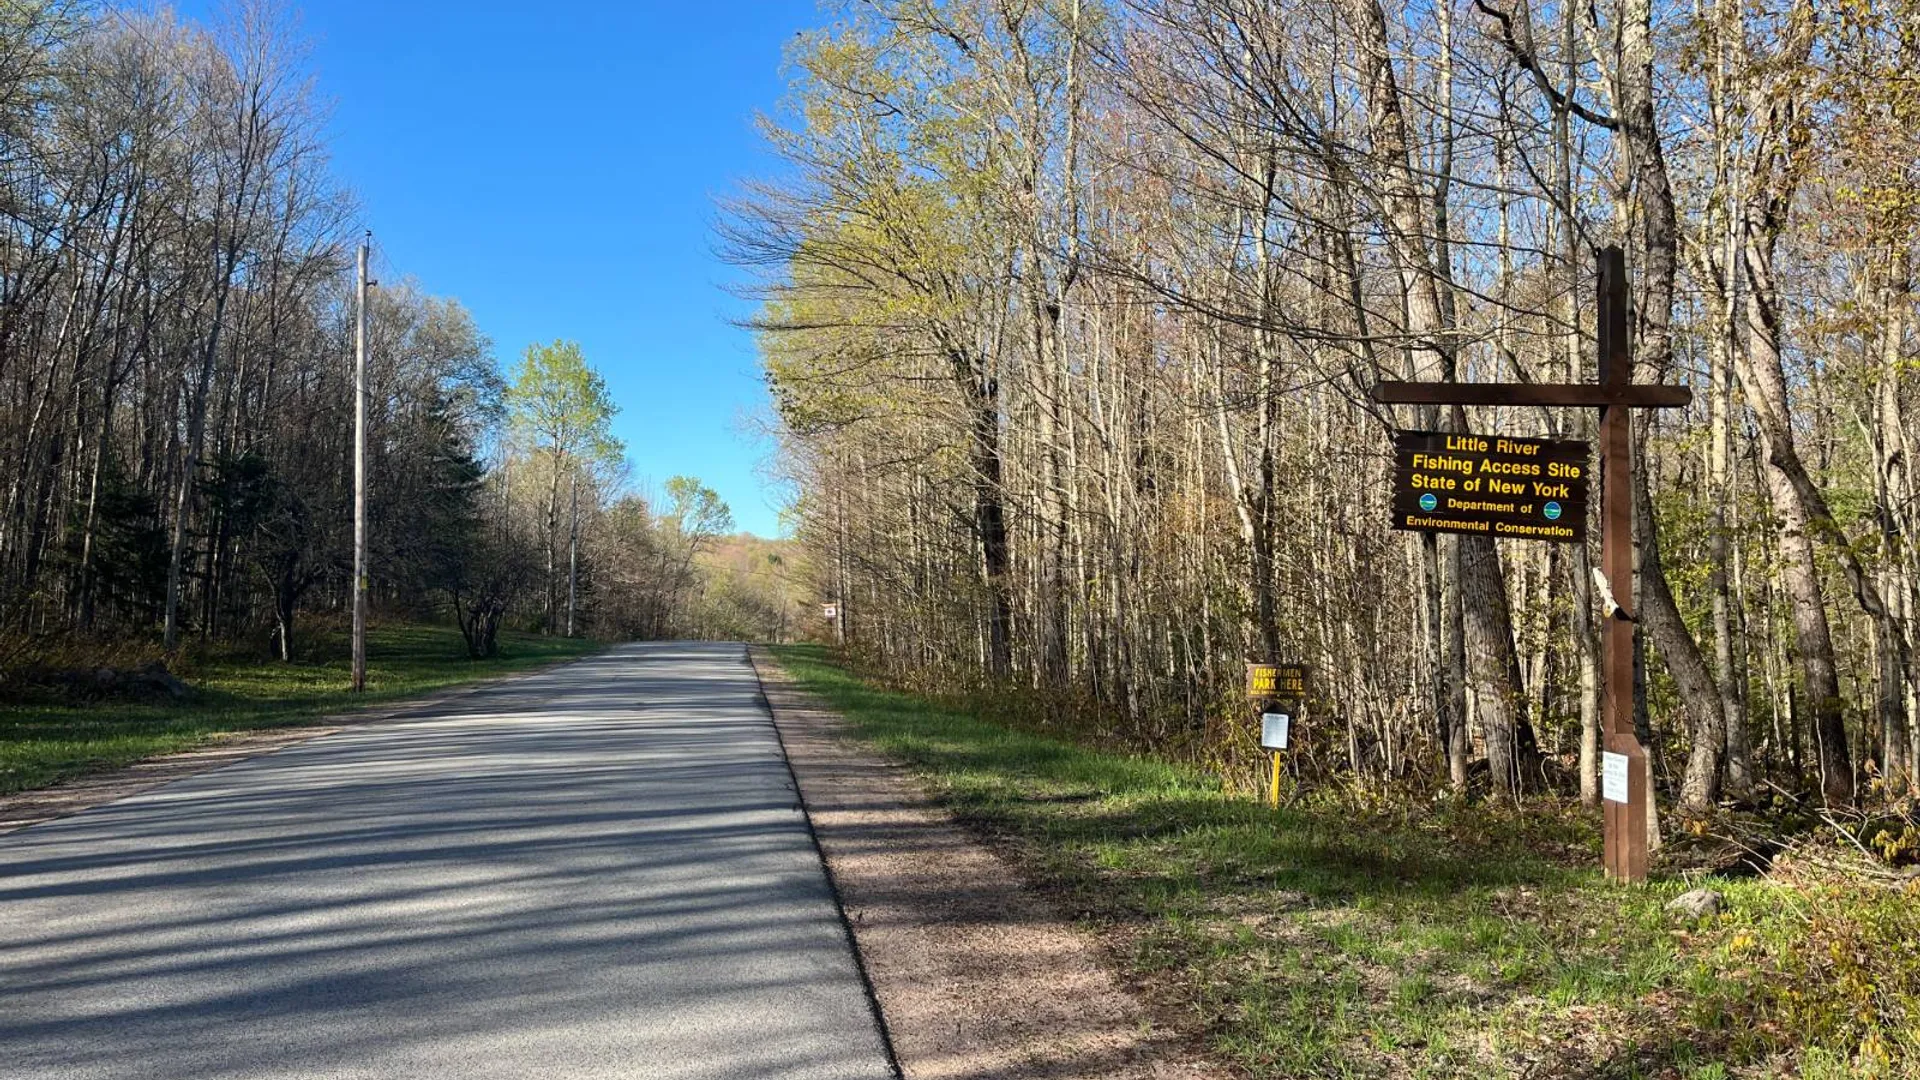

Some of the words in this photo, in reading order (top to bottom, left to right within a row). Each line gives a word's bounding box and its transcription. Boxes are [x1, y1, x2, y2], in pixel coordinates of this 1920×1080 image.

[1446, 436, 1488, 452] Little
[1496, 439, 1540, 456] River
[1413, 454, 1473, 474] Fishing
[1480, 459, 1540, 476] Access
[1548, 462, 1581, 478] Site
[1411, 474, 1456, 490] State
[1464, 477, 1481, 492] of
[1489, 479, 1526, 495] New
[1533, 482, 1569, 498] York
[1447, 498, 1515, 513] Department
[1520, 504, 1533, 514] of
[1406, 515, 1489, 531] Environmental
[1495, 522, 1574, 537] Conservation
[1252, 678, 1276, 690] PARK
[1281, 678, 1304, 690] HERE
